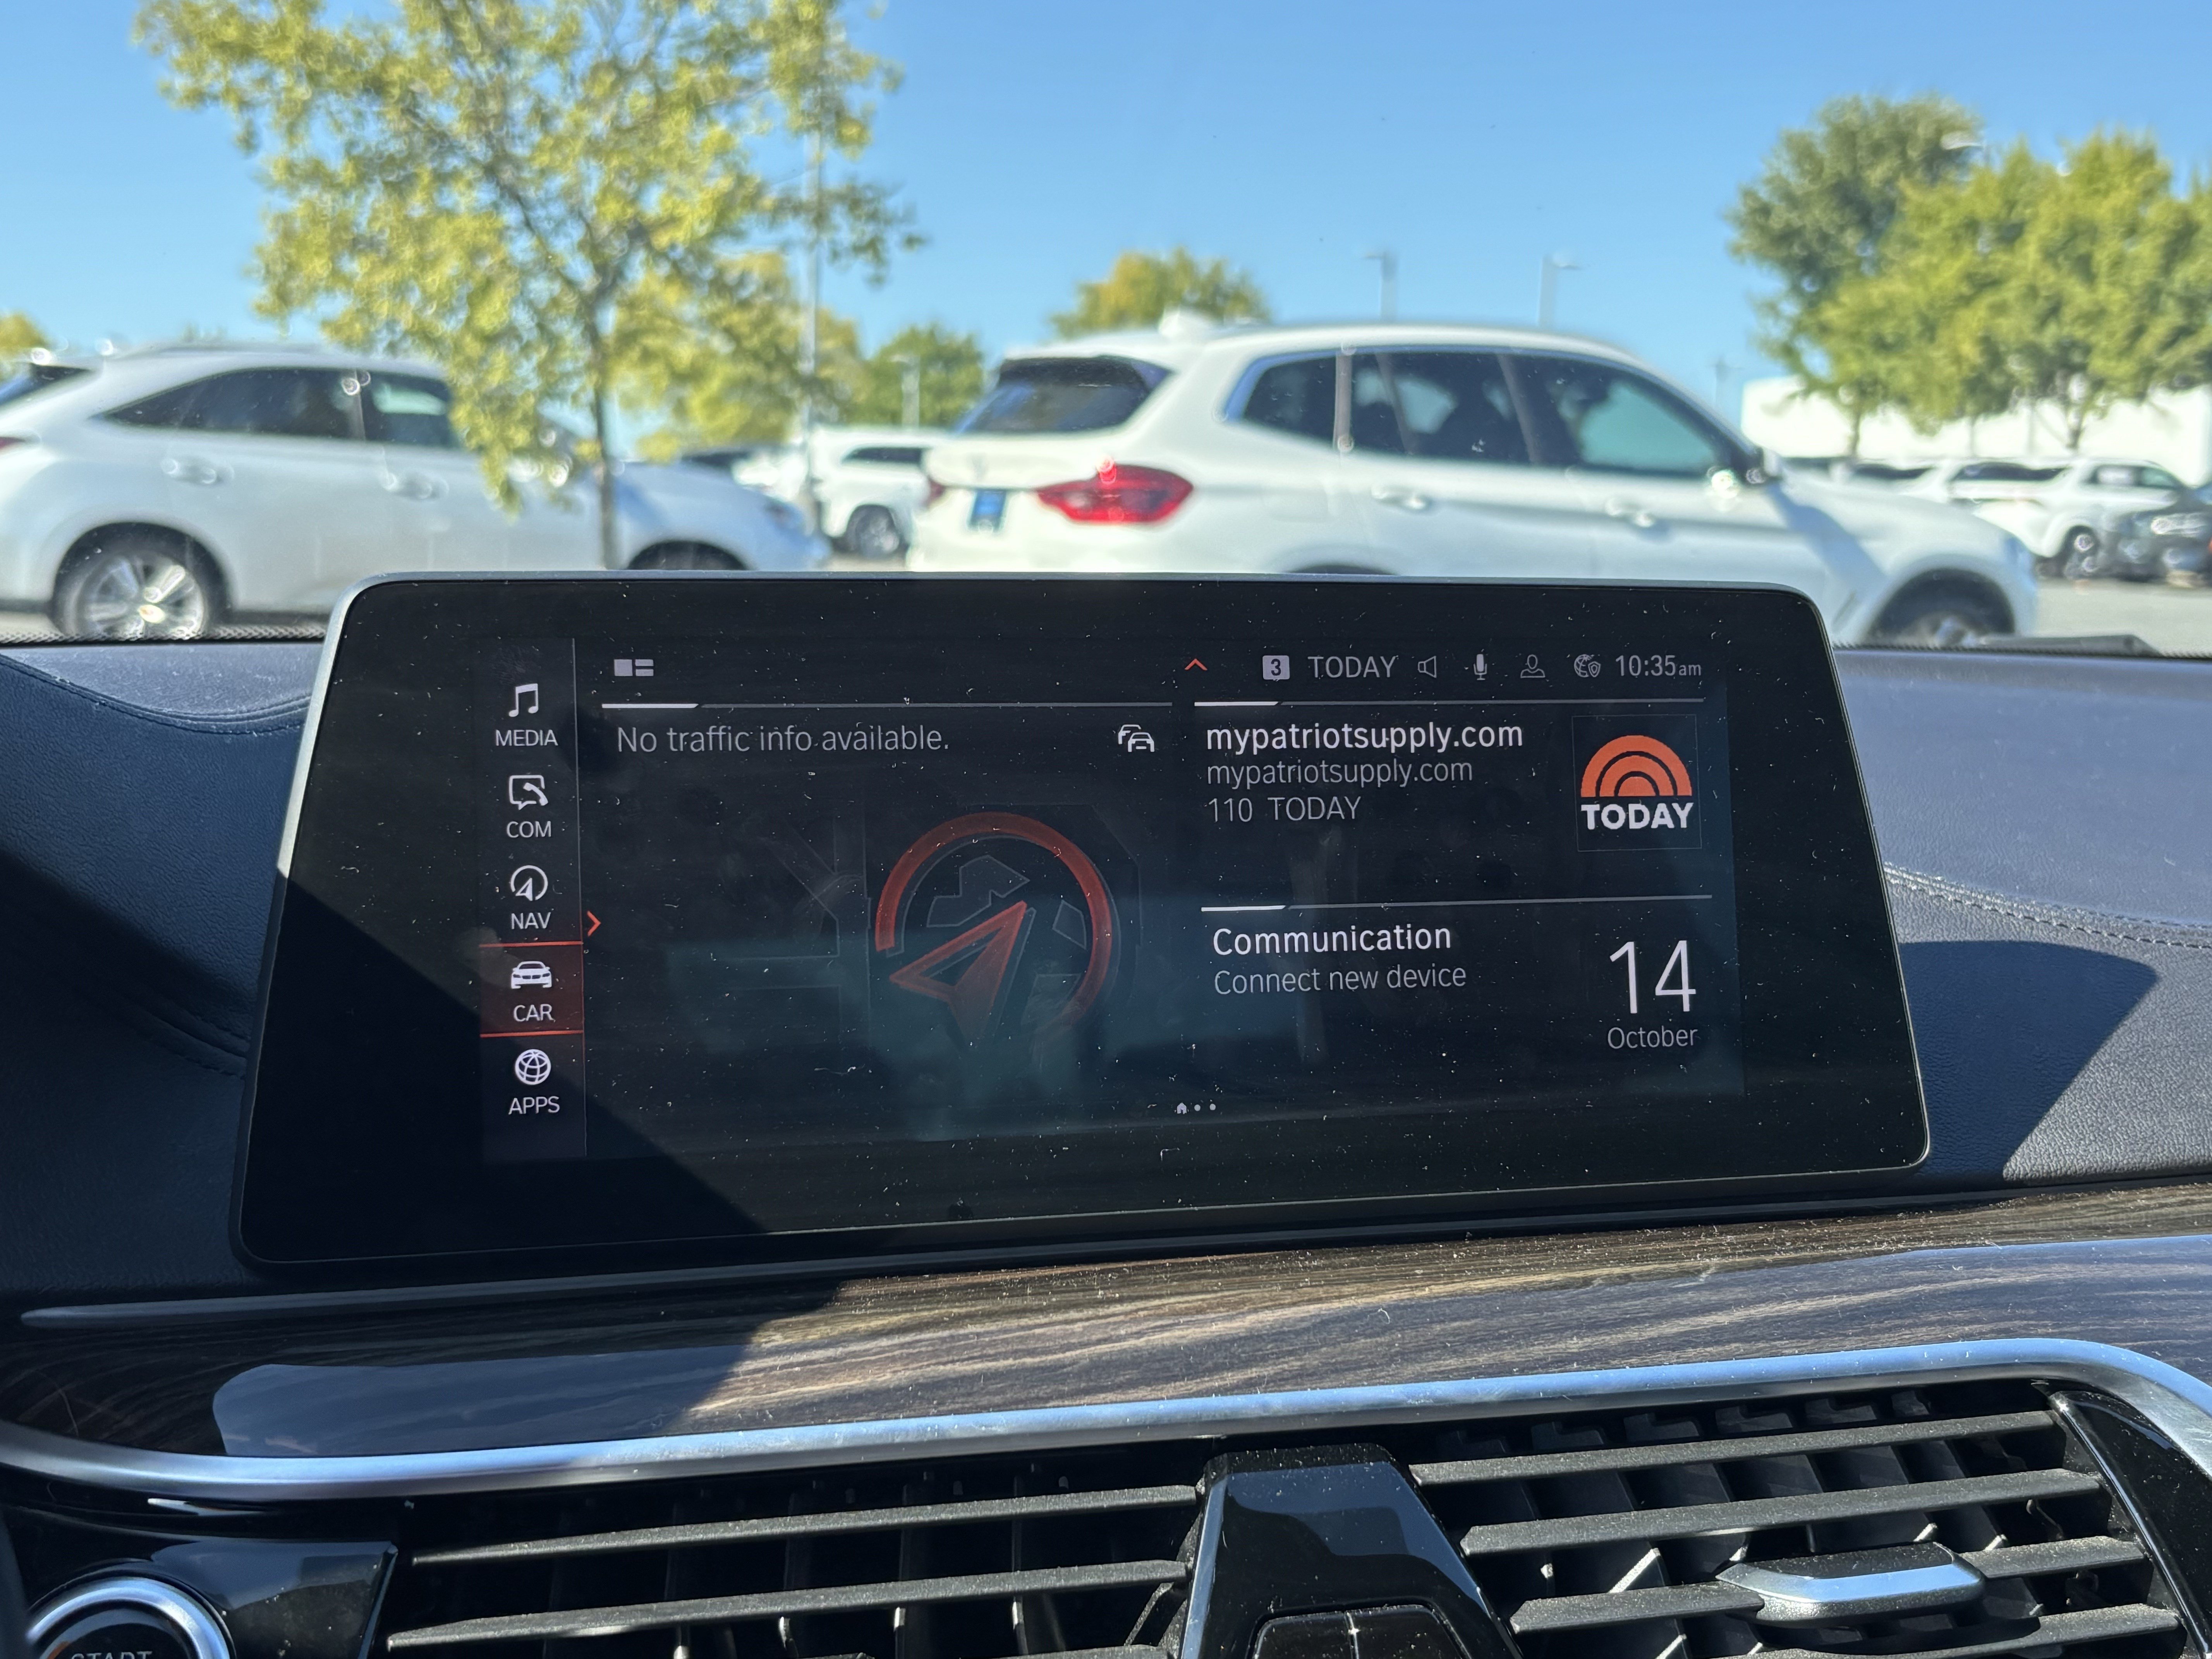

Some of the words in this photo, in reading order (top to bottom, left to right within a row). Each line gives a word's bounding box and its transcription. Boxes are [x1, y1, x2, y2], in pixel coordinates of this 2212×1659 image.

[1271, 658, 1282, 676] 3
[1308, 655, 1396, 678] TODAY
[495, 729, 558, 747] MEDIA
[618, 726, 658, 752] No
[666, 725, 750, 752] traffic
[760, 725, 812, 751] info
[821, 725, 949, 750] available.
[1207, 722, 1523, 755] mypatriotsupply.com
[1207, 759, 1473, 789] mypatriotsupply.com
[1208, 797, 1253, 823] 110
[1267, 795, 1362, 821] TODAY
[1580, 802, 1694, 830] TODAY
[506, 820, 552, 838] COM
[511, 912, 551, 930] NAV
[1212, 925, 1451, 956] Communication
[1214, 968, 1321, 995] Connect
[1329, 970, 1379, 990] new
[1386, 963, 1467, 988] device
[1609, 940, 1697, 1014] 14
[513, 1004, 553, 1022] CAR
[1607, 1025, 1698, 1049] October
[508, 1096, 560, 1115] APPS
